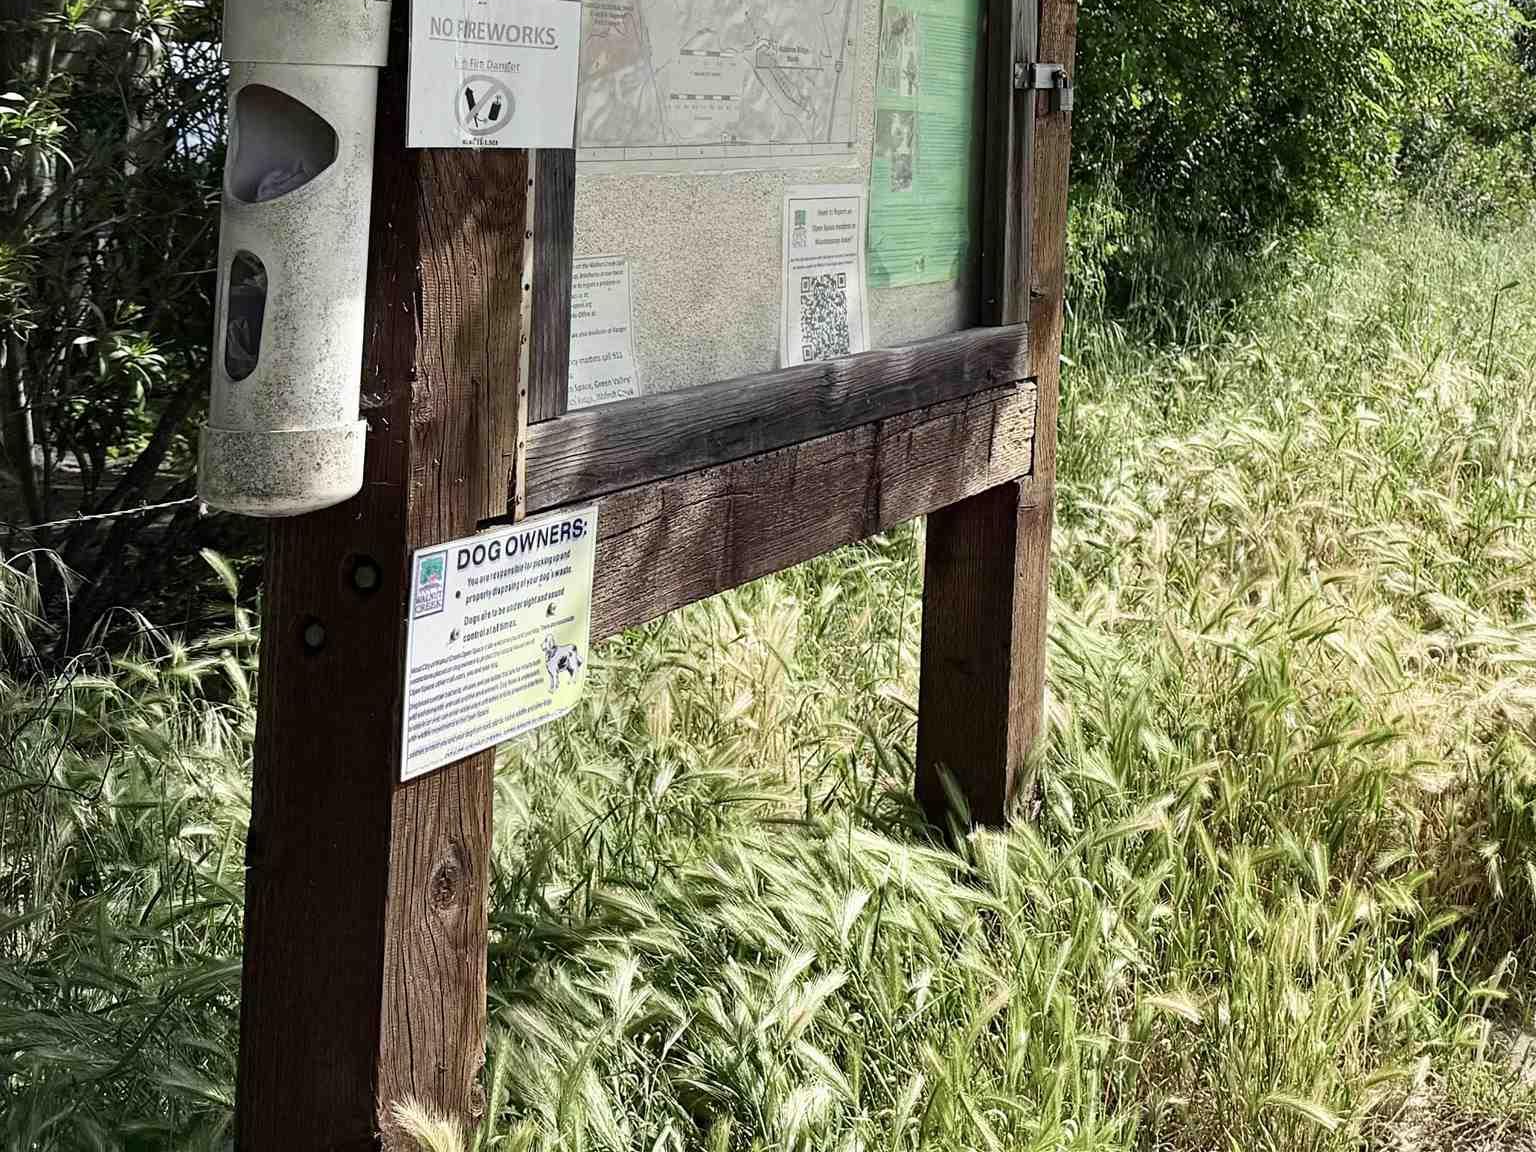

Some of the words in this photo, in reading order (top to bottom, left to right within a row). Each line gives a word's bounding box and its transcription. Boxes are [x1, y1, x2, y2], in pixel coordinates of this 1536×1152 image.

[430, 16, 453, 37] NO
[457, 19, 556, 46] FIREWORKS
[457, 540, 501, 570] DOG
[505, 518, 588, 556] OWNERS:
[467, 575, 479, 587] You
